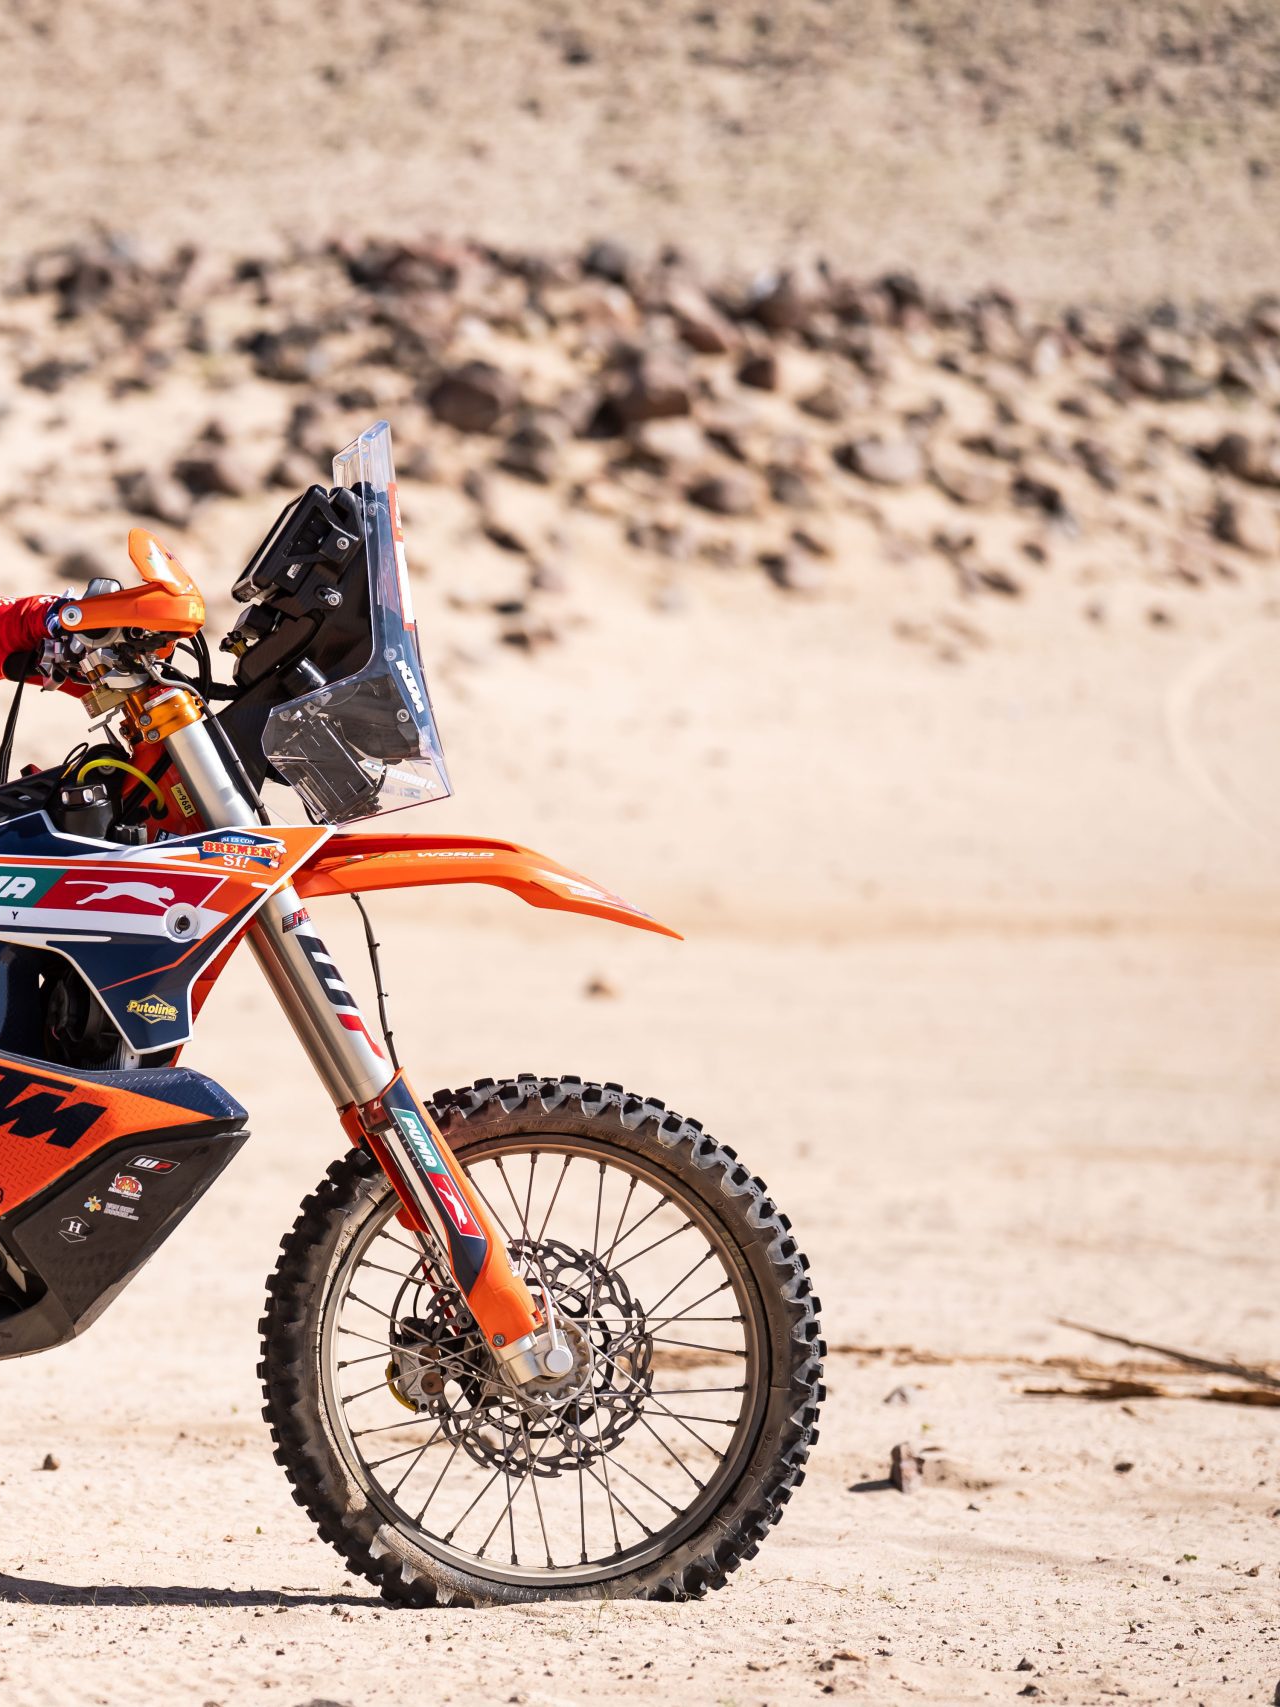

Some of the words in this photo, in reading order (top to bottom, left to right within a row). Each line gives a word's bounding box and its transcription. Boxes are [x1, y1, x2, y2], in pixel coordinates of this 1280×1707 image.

[395, 660, 425, 713] KTM
[179, 795, 195, 815] 9681
[202, 840, 273, 859] BREMEN
[127, 1001, 177, 1016] Putoline
[400, 1116, 438, 1168] PUMA
[133, 1157, 173, 1171] WP
